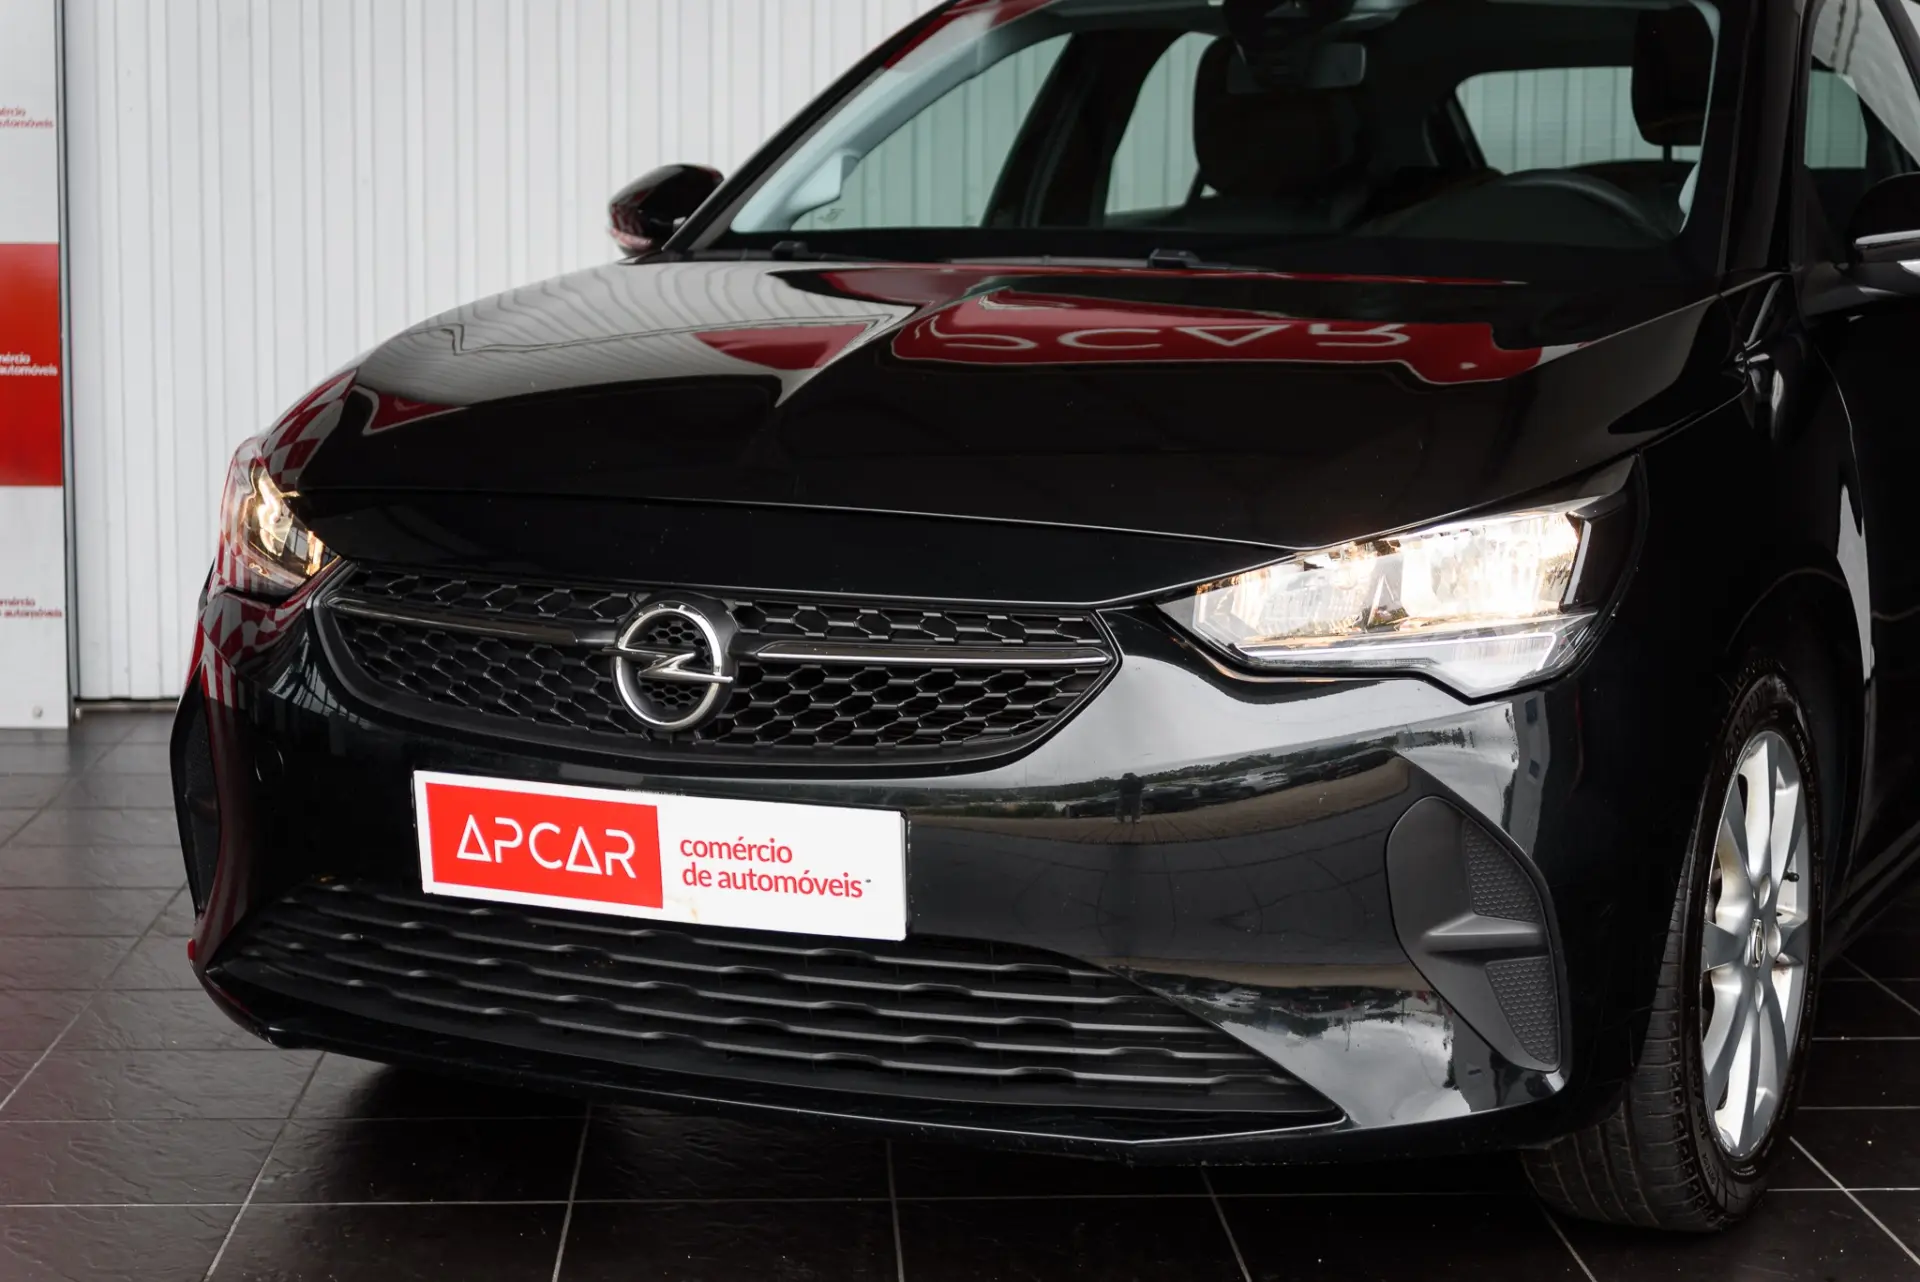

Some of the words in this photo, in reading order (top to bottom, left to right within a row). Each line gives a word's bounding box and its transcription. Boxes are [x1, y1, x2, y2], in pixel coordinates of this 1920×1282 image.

[456, 814, 637, 879] APCAR
[679, 836, 793, 863] comércio
[682, 862, 712, 887] de
[717, 868, 864, 898] automóveis
